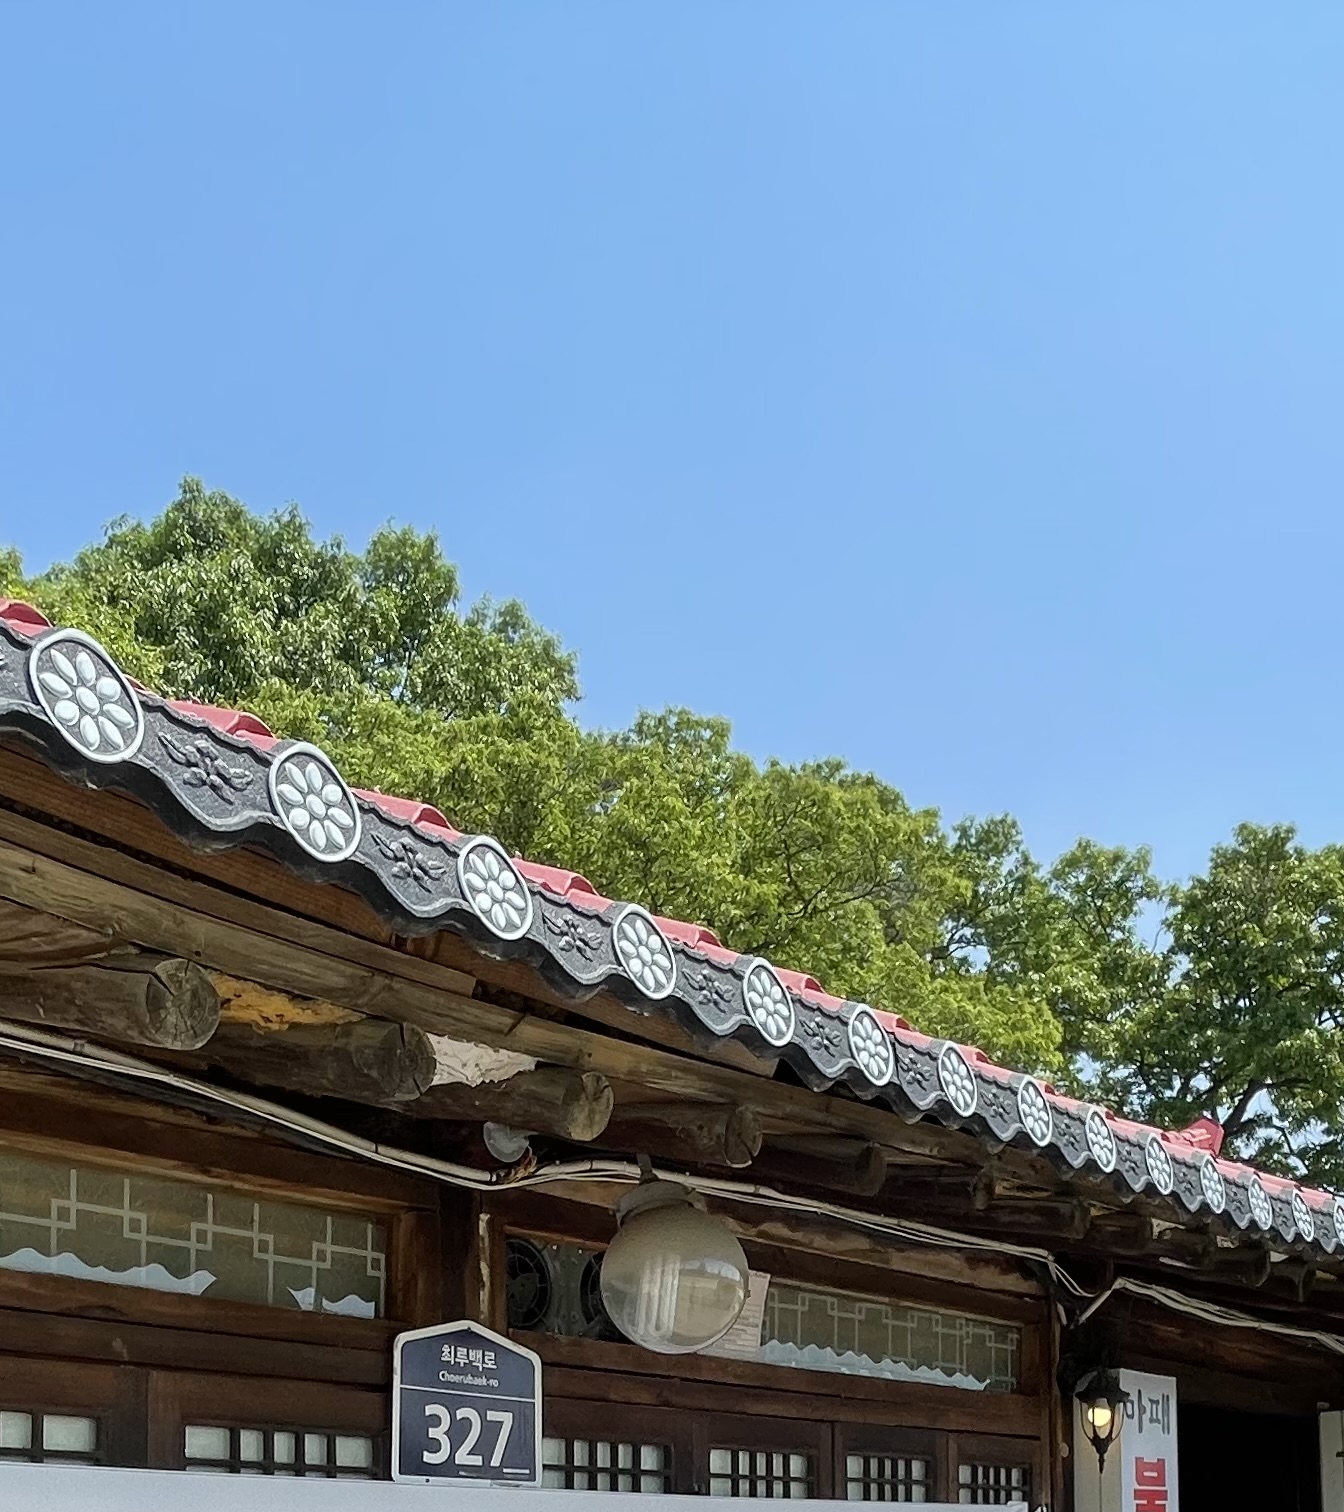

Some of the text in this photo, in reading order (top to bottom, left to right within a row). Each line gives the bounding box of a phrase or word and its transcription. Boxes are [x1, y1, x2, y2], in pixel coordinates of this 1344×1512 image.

[440, 1344, 498, 1372] 최루백로
[439, 1370, 499, 1388] Choerubaek-ro
[422, 1403, 514, 1467] 327
